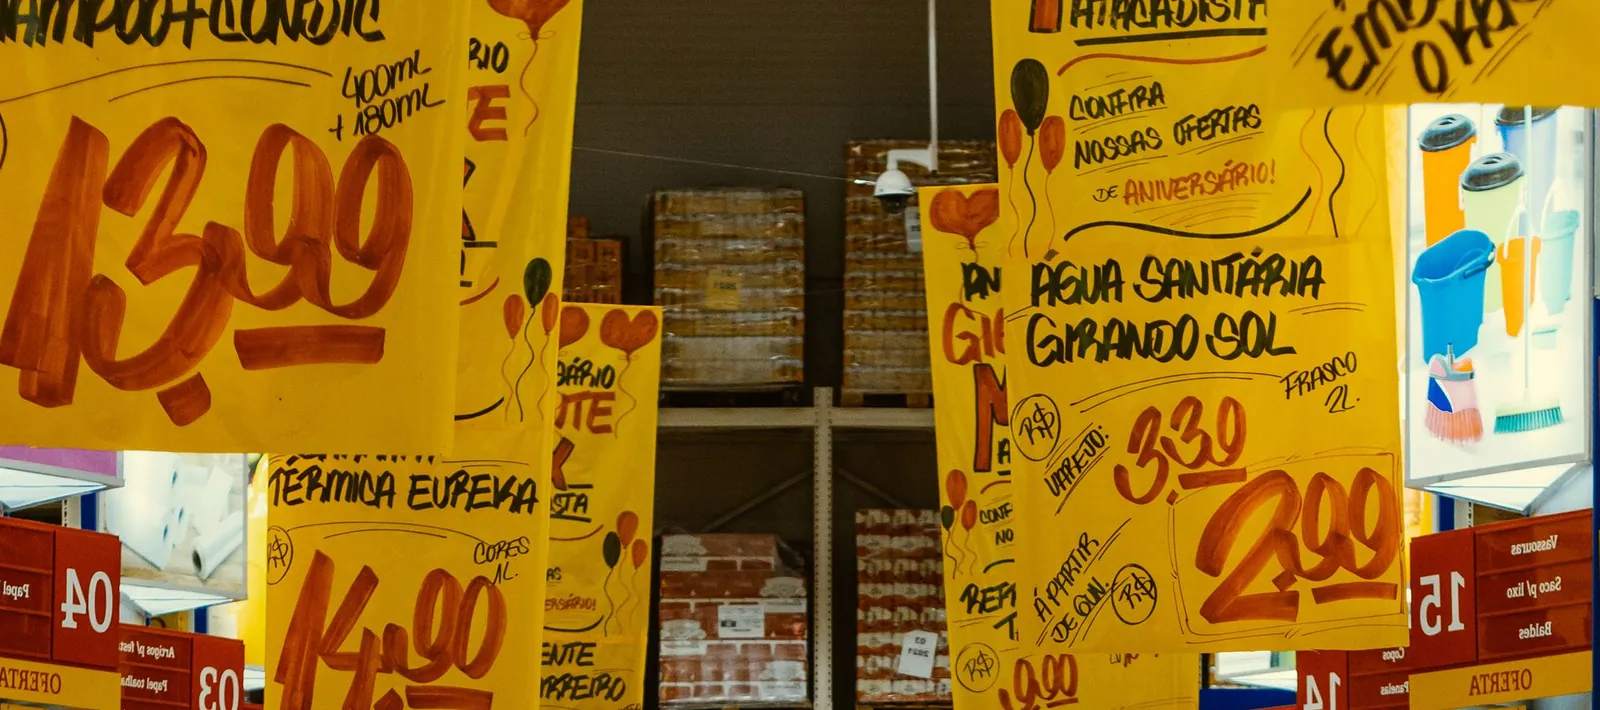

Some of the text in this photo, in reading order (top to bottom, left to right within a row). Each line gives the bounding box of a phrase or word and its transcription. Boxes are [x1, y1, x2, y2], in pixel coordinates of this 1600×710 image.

[1069, 81, 1165, 121] CONFIRA
[1074, 103, 1262, 169] NOSSAS OFERTAS
[1092, 158, 1276, 206] DE ANIVERSÁRIO!
[1030, 246, 1327, 306] ÁGUA SANITÁRIA
[1026, 310, 1297, 367] GIRANDO SOL
[1279, 351, 1358, 400] FRASCO
[267, 454, 540, 515] TÉRMICA EUREKA
[1044, 424, 1109, 497] VAREJO:
[473, 536, 531, 565] CORES
[1046, 532, 1100, 607] PARTIR
[1050, 612, 1078, 643] DE
